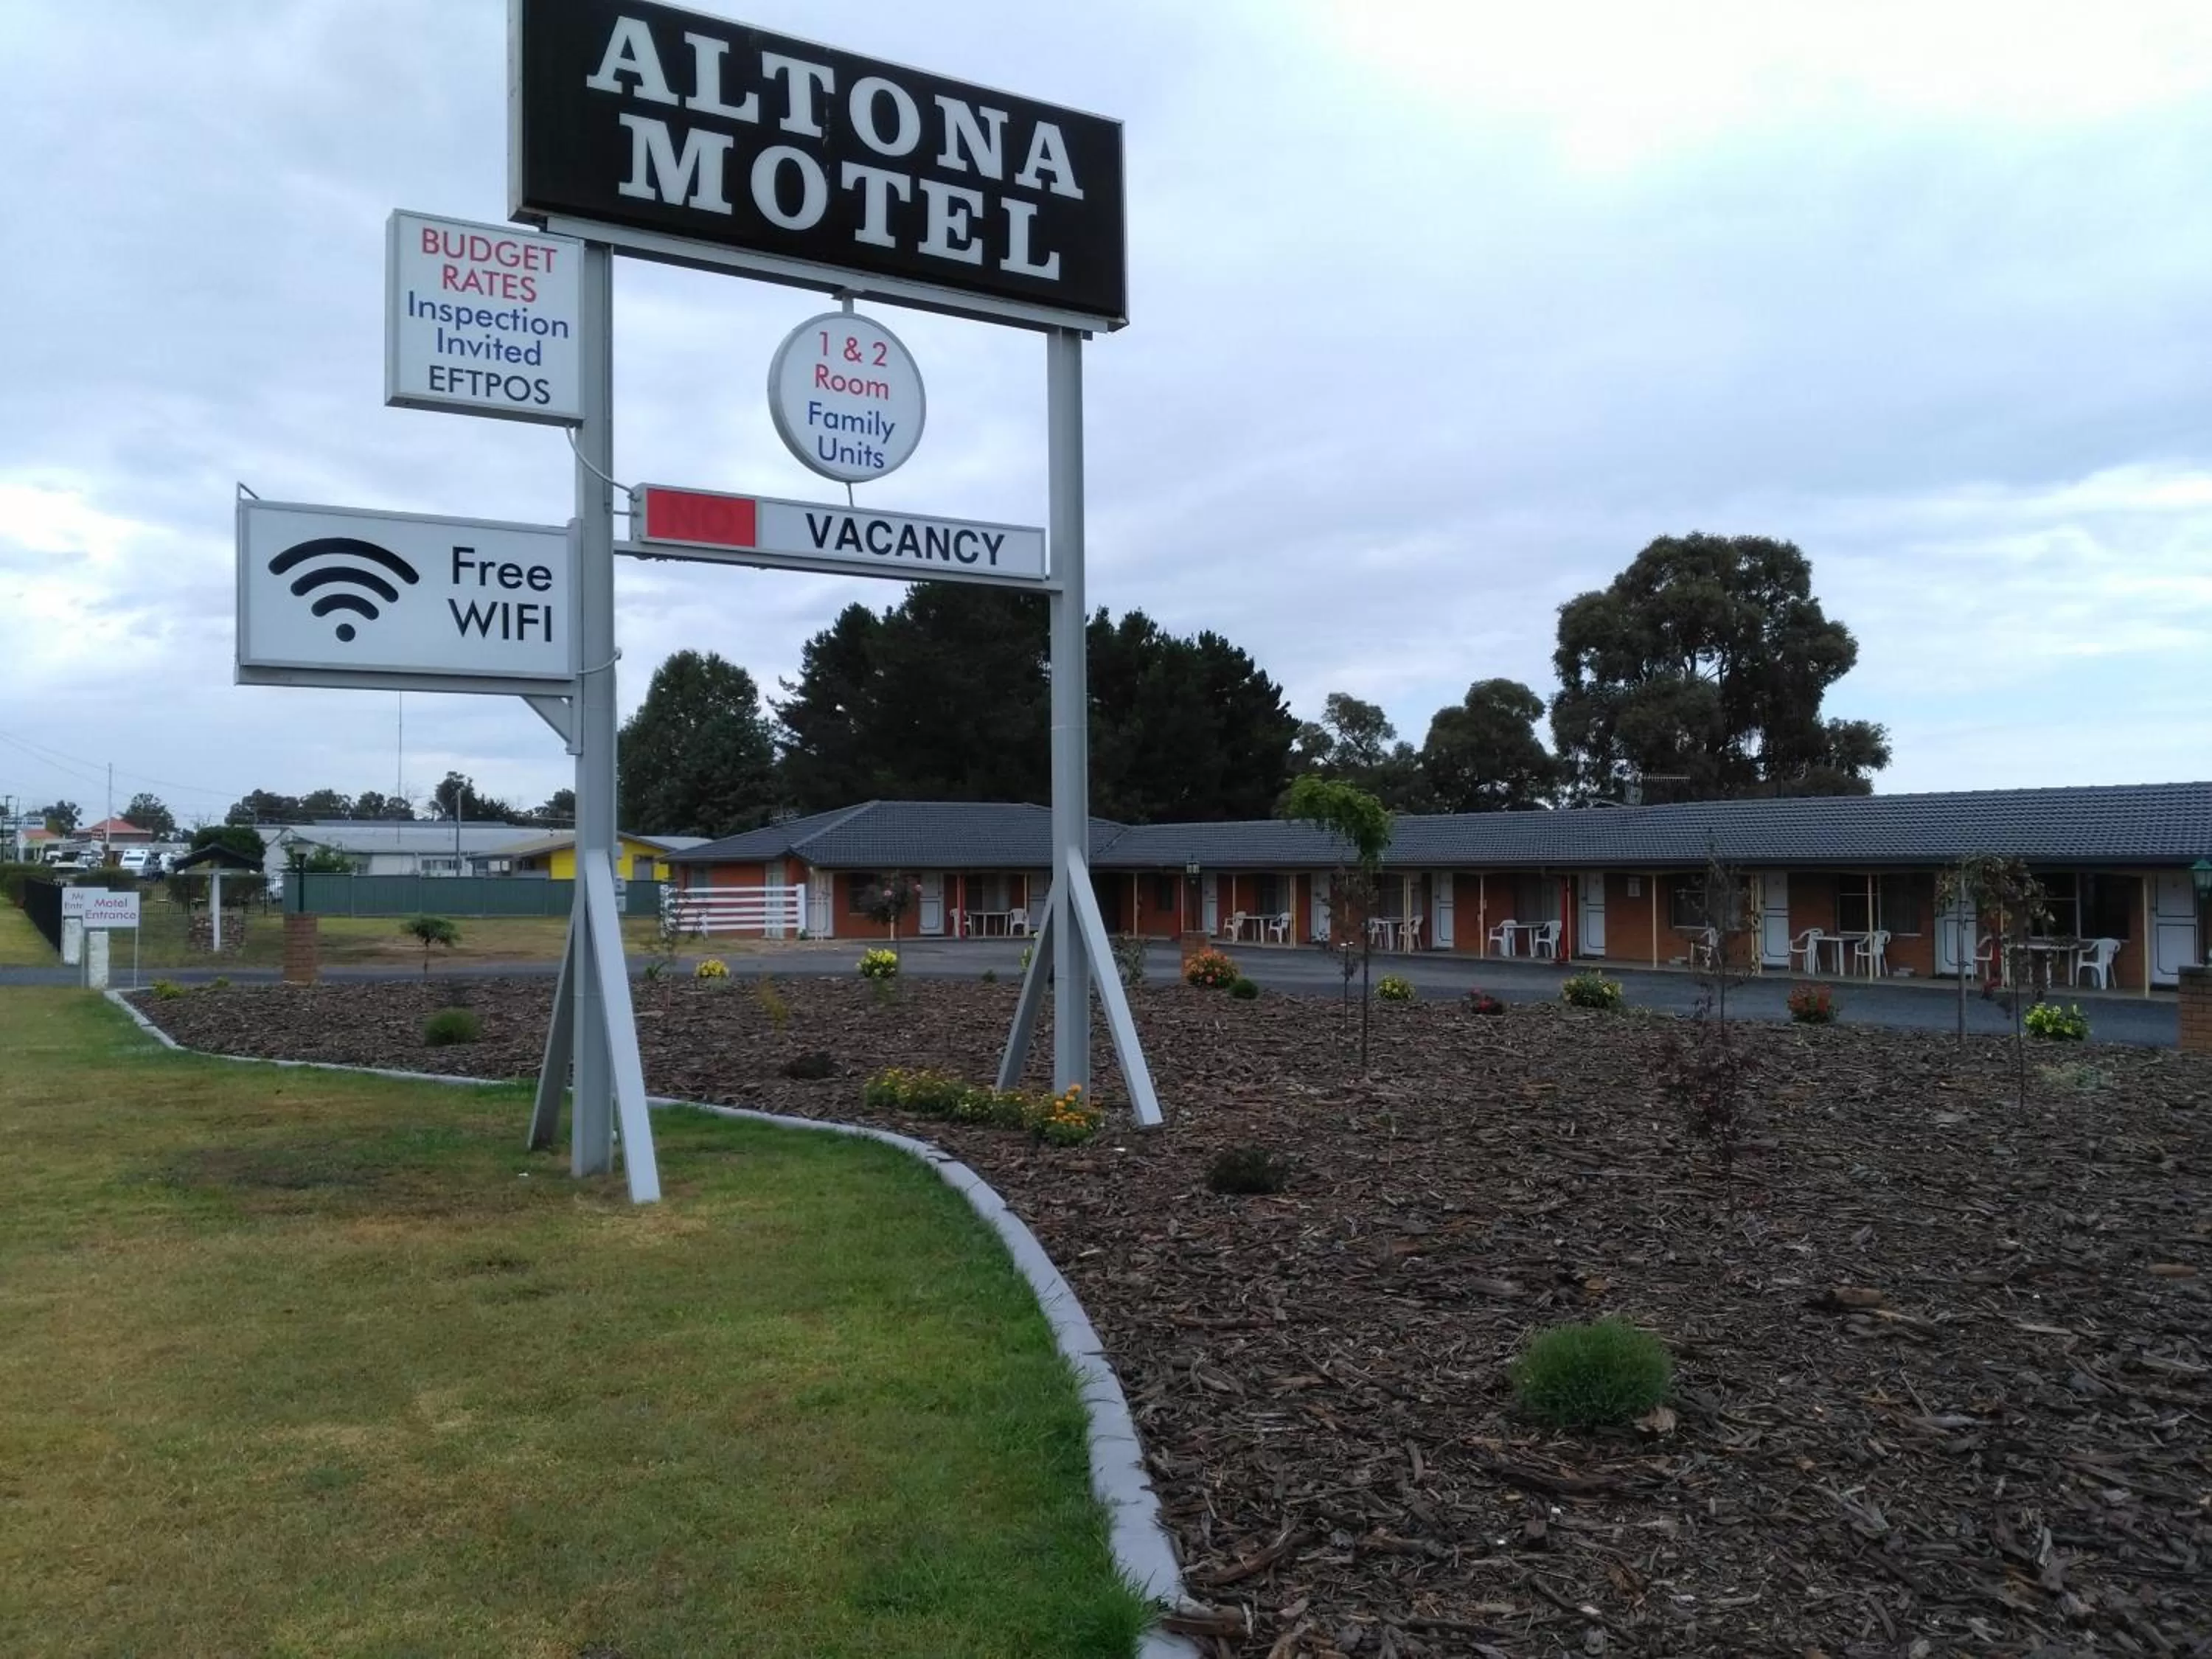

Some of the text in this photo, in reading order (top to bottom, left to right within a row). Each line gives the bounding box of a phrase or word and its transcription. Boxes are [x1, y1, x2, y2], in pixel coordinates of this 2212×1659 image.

[586, 15, 1084, 200] ALTONA
[618, 113, 1060, 280] MOTEL
[422, 227, 557, 273] BUDGET
[442, 264, 537, 303] RATES
[408, 291, 568, 338] Inspection
[437, 327, 541, 366] Invited
[819, 331, 888, 366] 1 & 2
[429, 365, 551, 405] EFTPOS
[814, 364, 889, 400] Room
[808, 401, 895, 444] Family
[818, 436, 884, 468] Units
[806, 513, 1005, 566] VACANCY
[452, 546, 552, 591] Free
[448, 599, 552, 642] WIFI
[85, 909, 136, 919] Entrance
[94, 898, 128, 908] Motel
